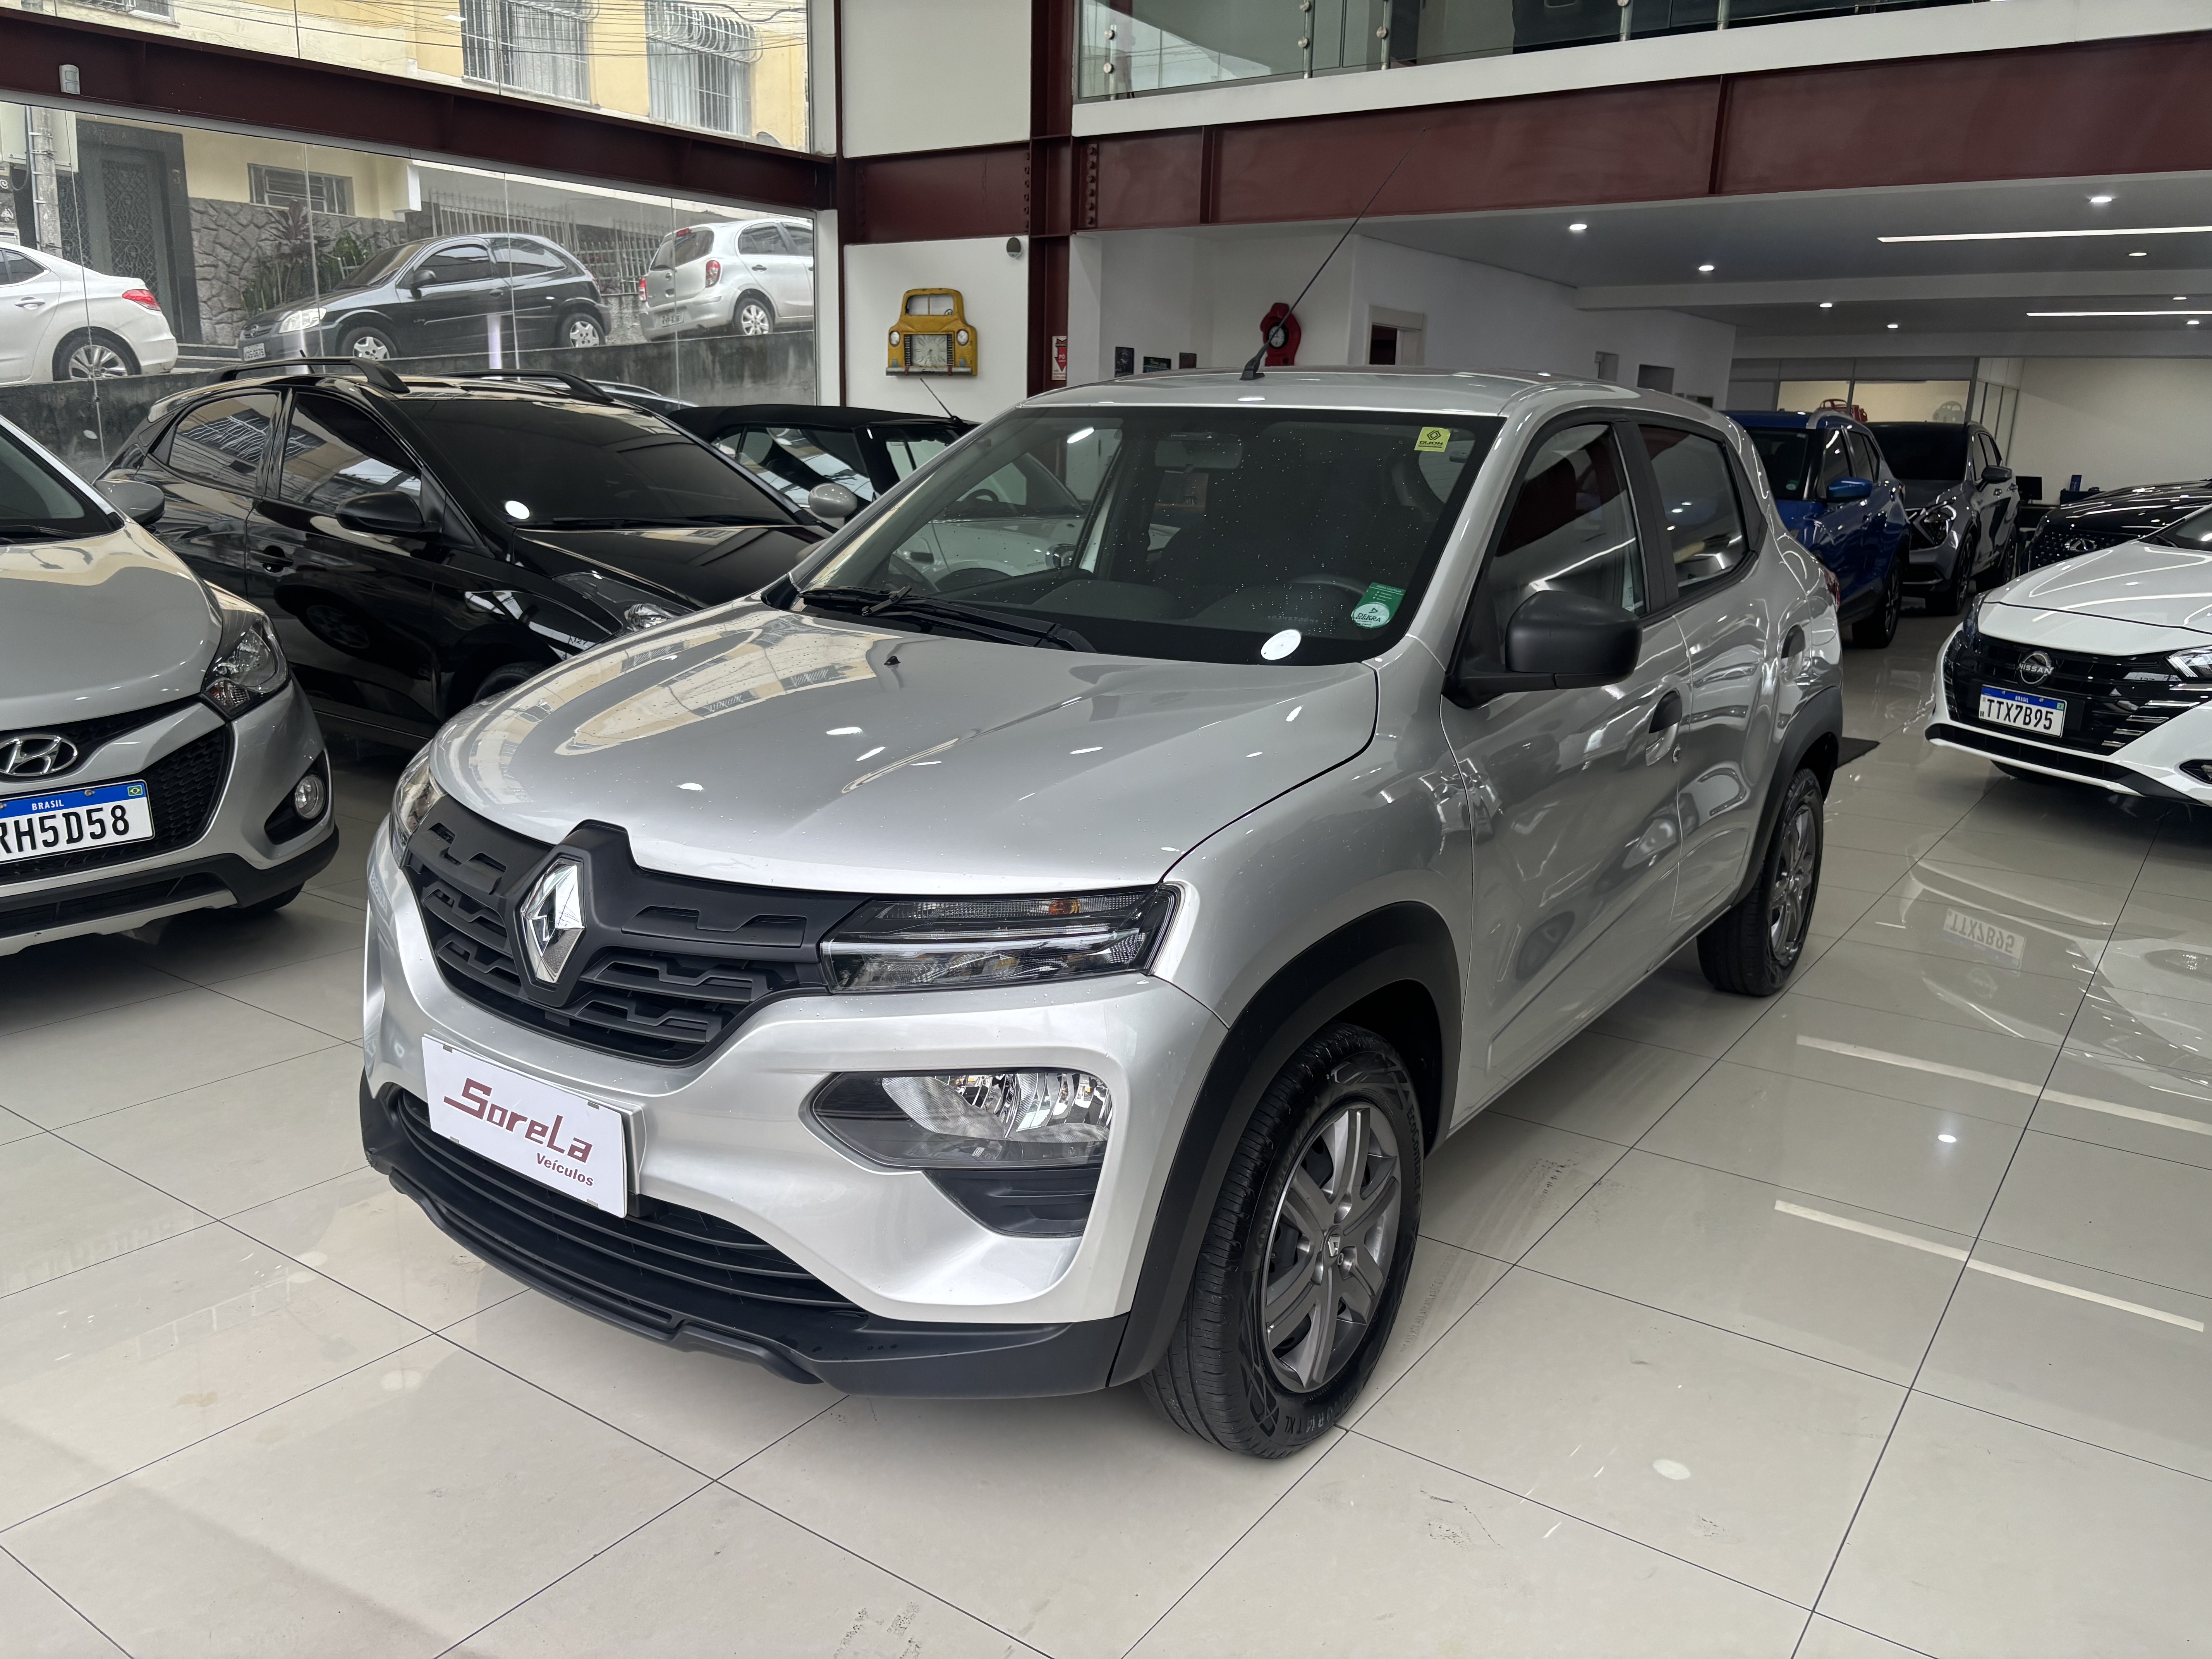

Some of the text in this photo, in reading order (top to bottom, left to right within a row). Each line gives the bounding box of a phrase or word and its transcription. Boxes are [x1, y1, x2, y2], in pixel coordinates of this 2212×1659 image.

[1357, 613, 1381, 622] DEKRA
[2018, 663, 2054, 675] NISSAN
[2014, 695, 2029, 704] BRASIL
[1987, 699, 2054, 730] TTX7B95
[31, 799, 64, 811] BRASIL
[537, 1152, 594, 1186] Veículos
